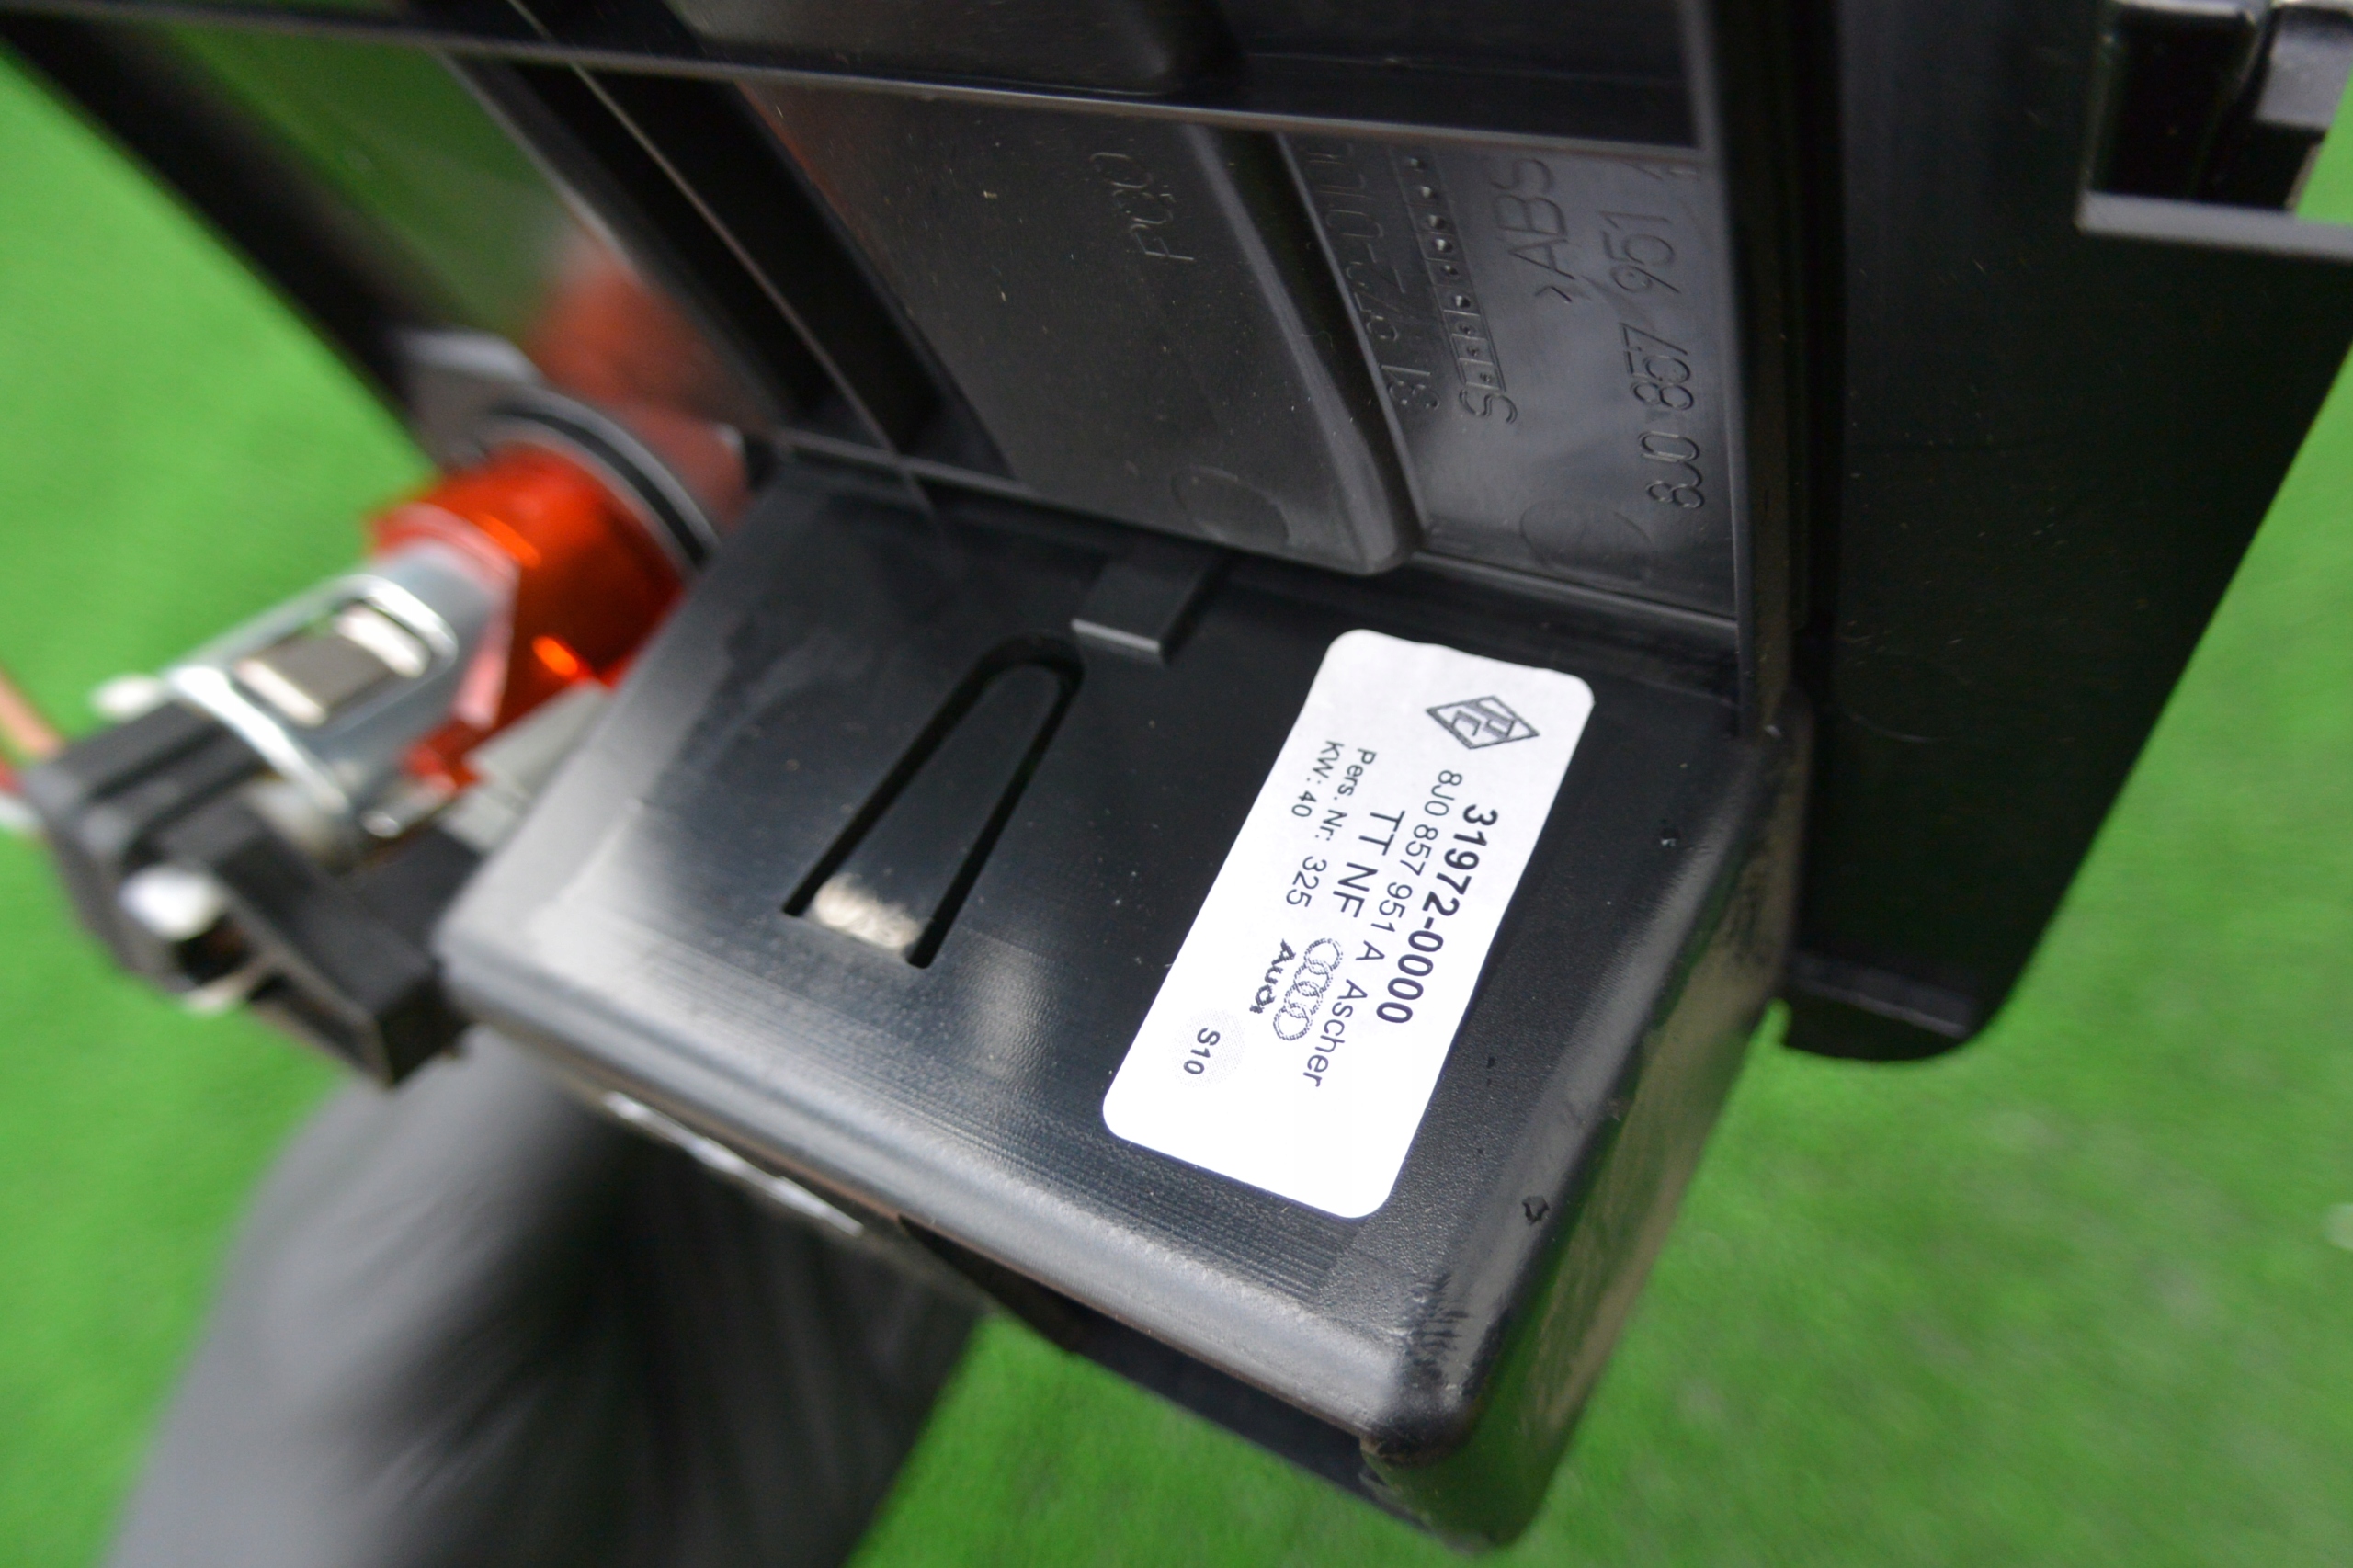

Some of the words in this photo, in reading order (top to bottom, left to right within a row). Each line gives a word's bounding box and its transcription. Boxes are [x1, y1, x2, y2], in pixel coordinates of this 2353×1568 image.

[1597, 210, 1681, 294] 951
[1620, 322, 1694, 411] 857
[1305, 740, 1345, 782] KW:
[1333, 747, 1377, 802] Pers.
[1290, 790, 1317, 818] 40
[1424, 768, 1463, 817] 8J0
[1358, 809, 1406, 856] TT
[1399, 823, 1438, 876] 857
[1285, 855, 1327, 908] 325
[1333, 861, 1379, 918] NF
[1370, 881, 1414, 935] 951
[1375, 803, 1499, 1024] 31972-0000
[1354, 939, 1385, 963] A
[1182, 1027, 1222, 1076] S10
[1302, 979, 1369, 1087] Ascher
